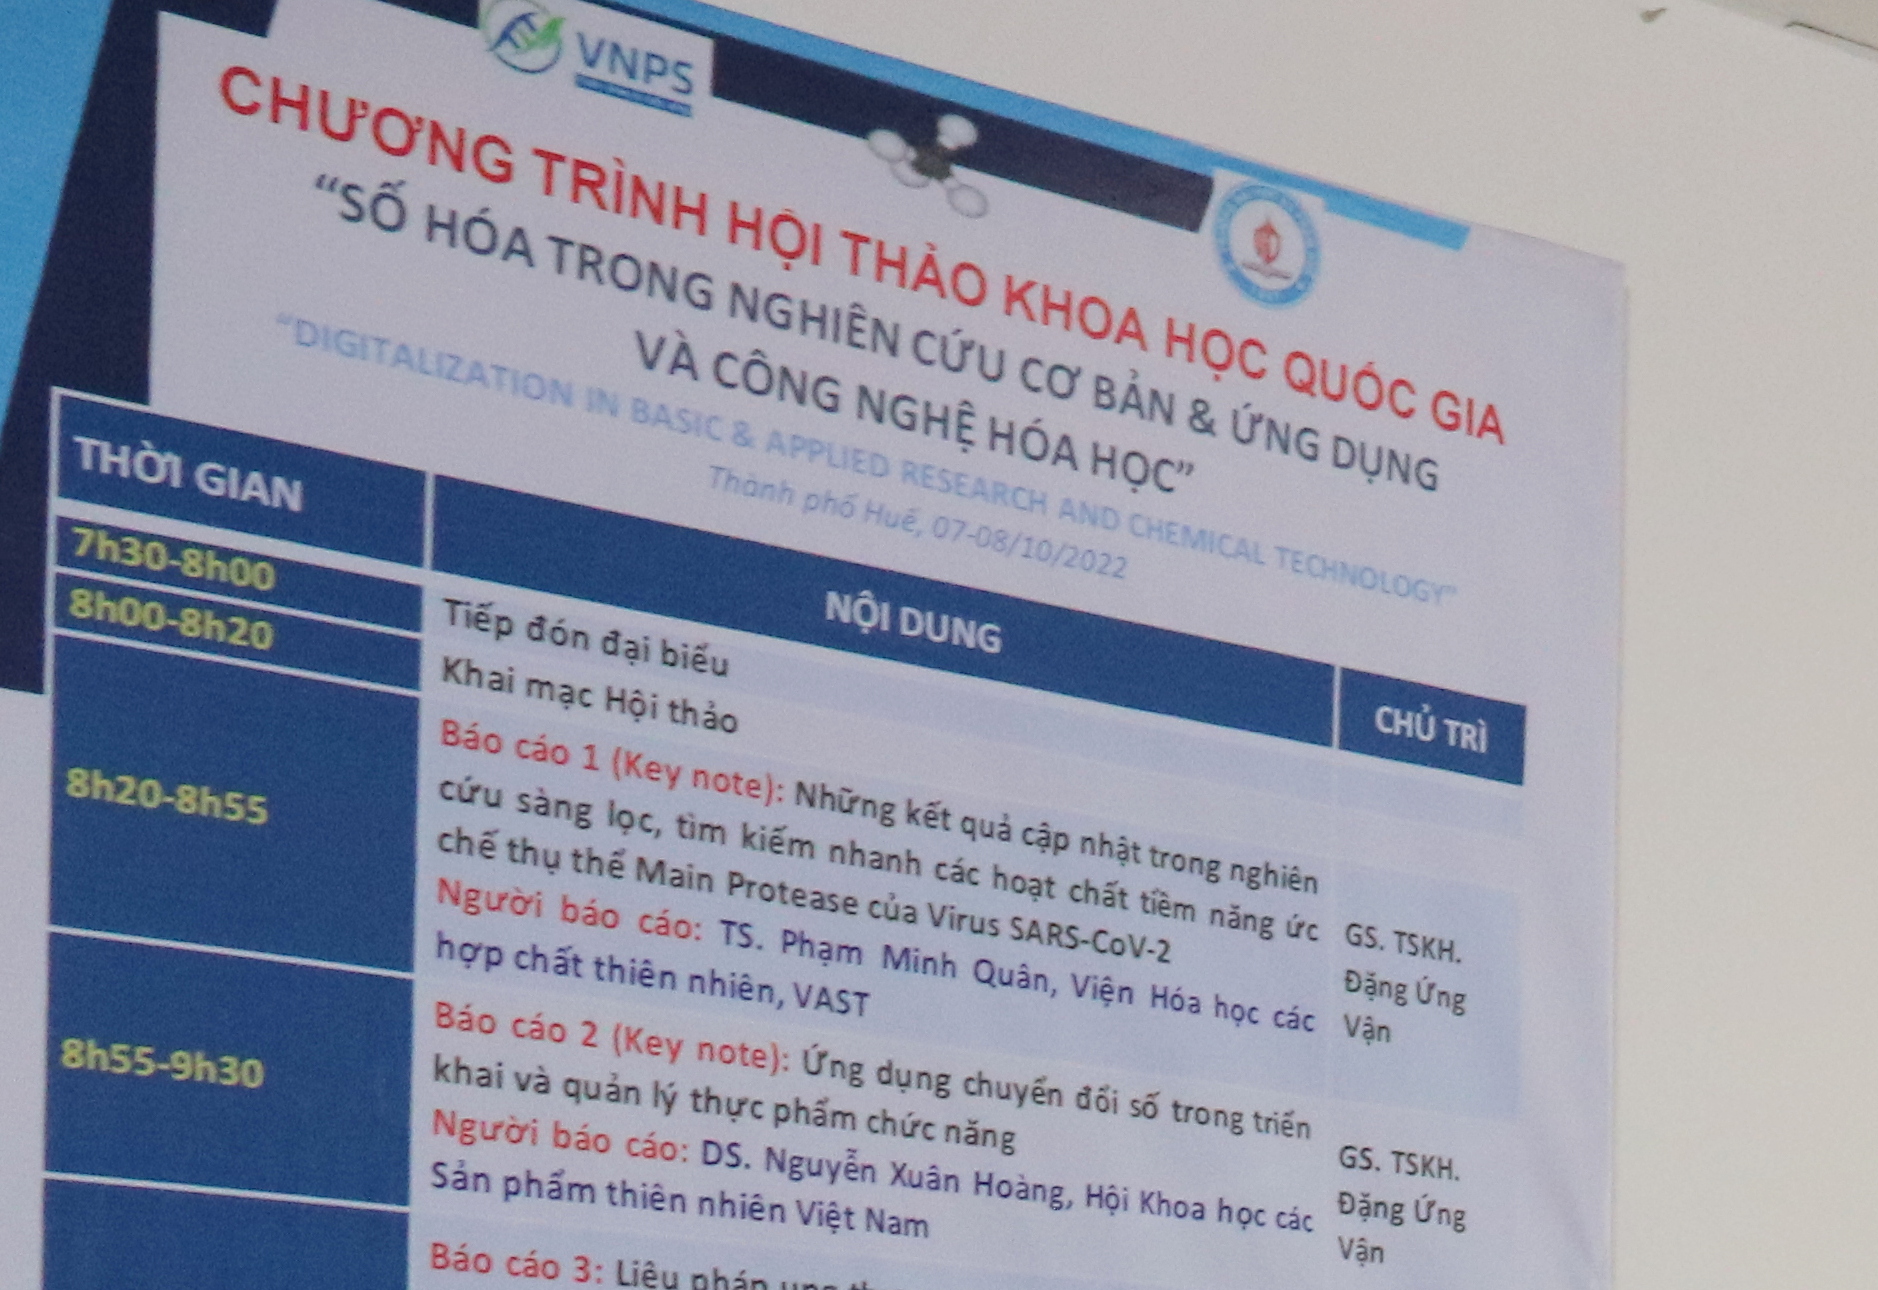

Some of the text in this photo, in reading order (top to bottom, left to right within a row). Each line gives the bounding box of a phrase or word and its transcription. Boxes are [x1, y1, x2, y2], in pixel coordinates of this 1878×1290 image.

[576, 31, 693, 95] VNPS
[219, 64, 513, 184] CHƯƠNG
[532, 146, 707, 236] TRÌNH
[728, 200, 822, 271] HỘI
[840, 229, 987, 307] THẢO
[1004, 274, 1148, 351] KHOA
[1165, 316, 1267, 382] HỌC
[1431, 389, 1505, 445] GIA
[425, 203, 536, 268] HÓA
[546, 233, 713, 311] TRONG
[729, 281, 900, 358] NGHIÊN
[911, 327, 1005, 384] CỨU
[1020, 355, 1082, 401] CƠ
[1094, 367, 1175, 426] BẢN
[1187, 397, 1217, 437] &
[1232, 401, 1320, 463] ỨNG
[1332, 433, 1438, 493] DỤNG
[634, 328, 700, 381] VÀ
[712, 347, 840, 414] CÔNG
[857, 383, 976, 454] NGHỆ
[988, 415, 1079, 471] HÓA
[73, 435, 303, 512] THỜI GIAN
[587, 387, 620, 417] IN
[631, 396, 722, 442] BASIC
[731, 419, 755, 448] &
[765, 429, 890, 478] APPLIED
[901, 459, 1047, 515] RESEARCH
[1058, 497, 1121, 531] AND
[1129, 512, 1266, 566] CHEMICAL
[709, 464, 794, 505] Thành
[932, 514, 1128, 580] 07-08/10/2022
[71, 525, 276, 592] 7h30-8h00
[70, 587, 273, 650] 8h00-8h20
[442, 596, 514, 641] Tiếp
[526, 614, 589, 650] đón
[601, 628, 650, 665] đại
[826, 589, 1001, 654] NỘI DUNG
[442, 655, 738, 734] Khai mạc Hội thảo
[1375, 703, 1487, 753] CHỦ TRÌ
[66, 766, 268, 825] 8h20-8h55
[441, 717, 1318, 894] Báo cáo 1 (Key note): Những kết quả cập nhật trong nghiên
[436, 930, 871, 1017] hợp chất thiên nhiên, VAST
[1344, 921, 1462, 964] GS. TSKH.
[1344, 968, 1467, 1017] Đặng Ứng
[1343, 1013, 1391, 1046] Vận
[62, 1037, 264, 1088] 8h55-9h30
[1338, 1143, 1460, 1181] GS. TSKH.
[1337, 1190, 1466, 1234] Đặng Ứng
[1337, 1235, 1385, 1267] Vận
